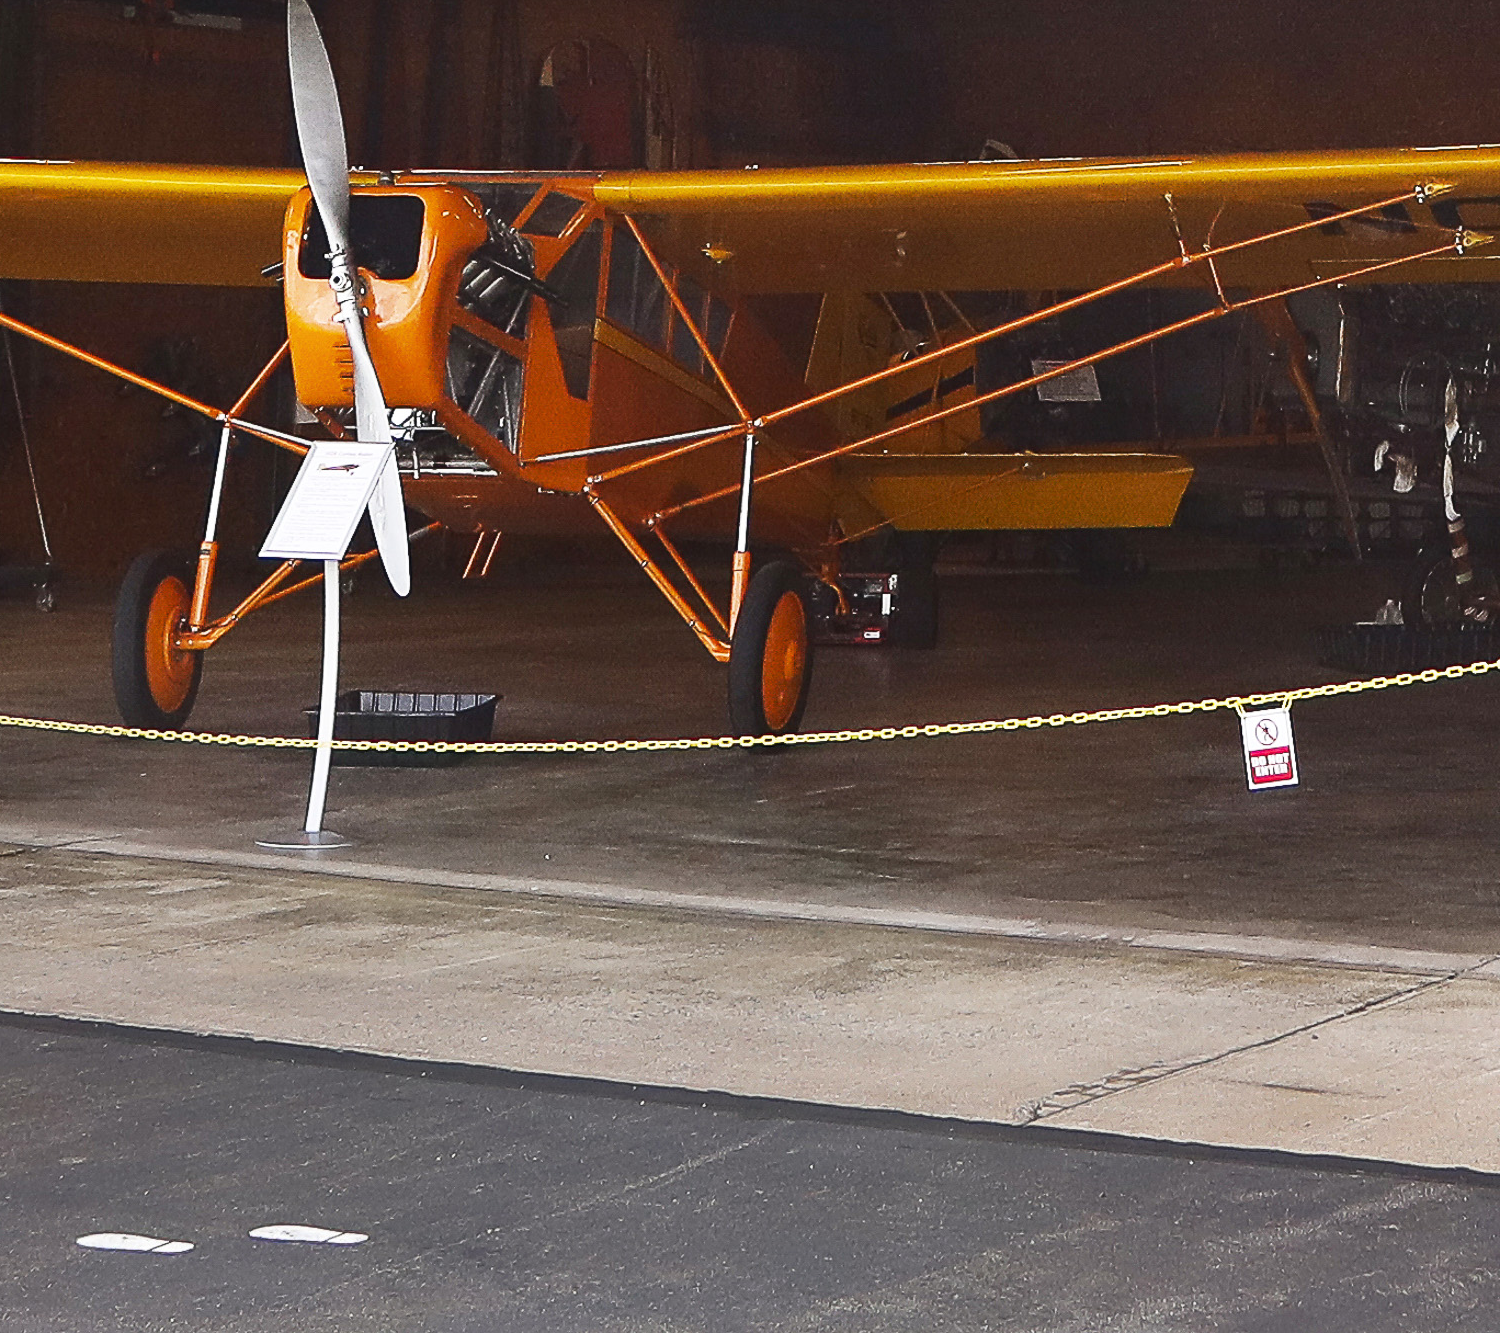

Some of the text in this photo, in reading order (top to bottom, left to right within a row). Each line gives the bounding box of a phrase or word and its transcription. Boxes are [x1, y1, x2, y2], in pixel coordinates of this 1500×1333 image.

[1250, 753, 1290, 768] DO NOT
[1254, 763, 1288, 777] ENTER
